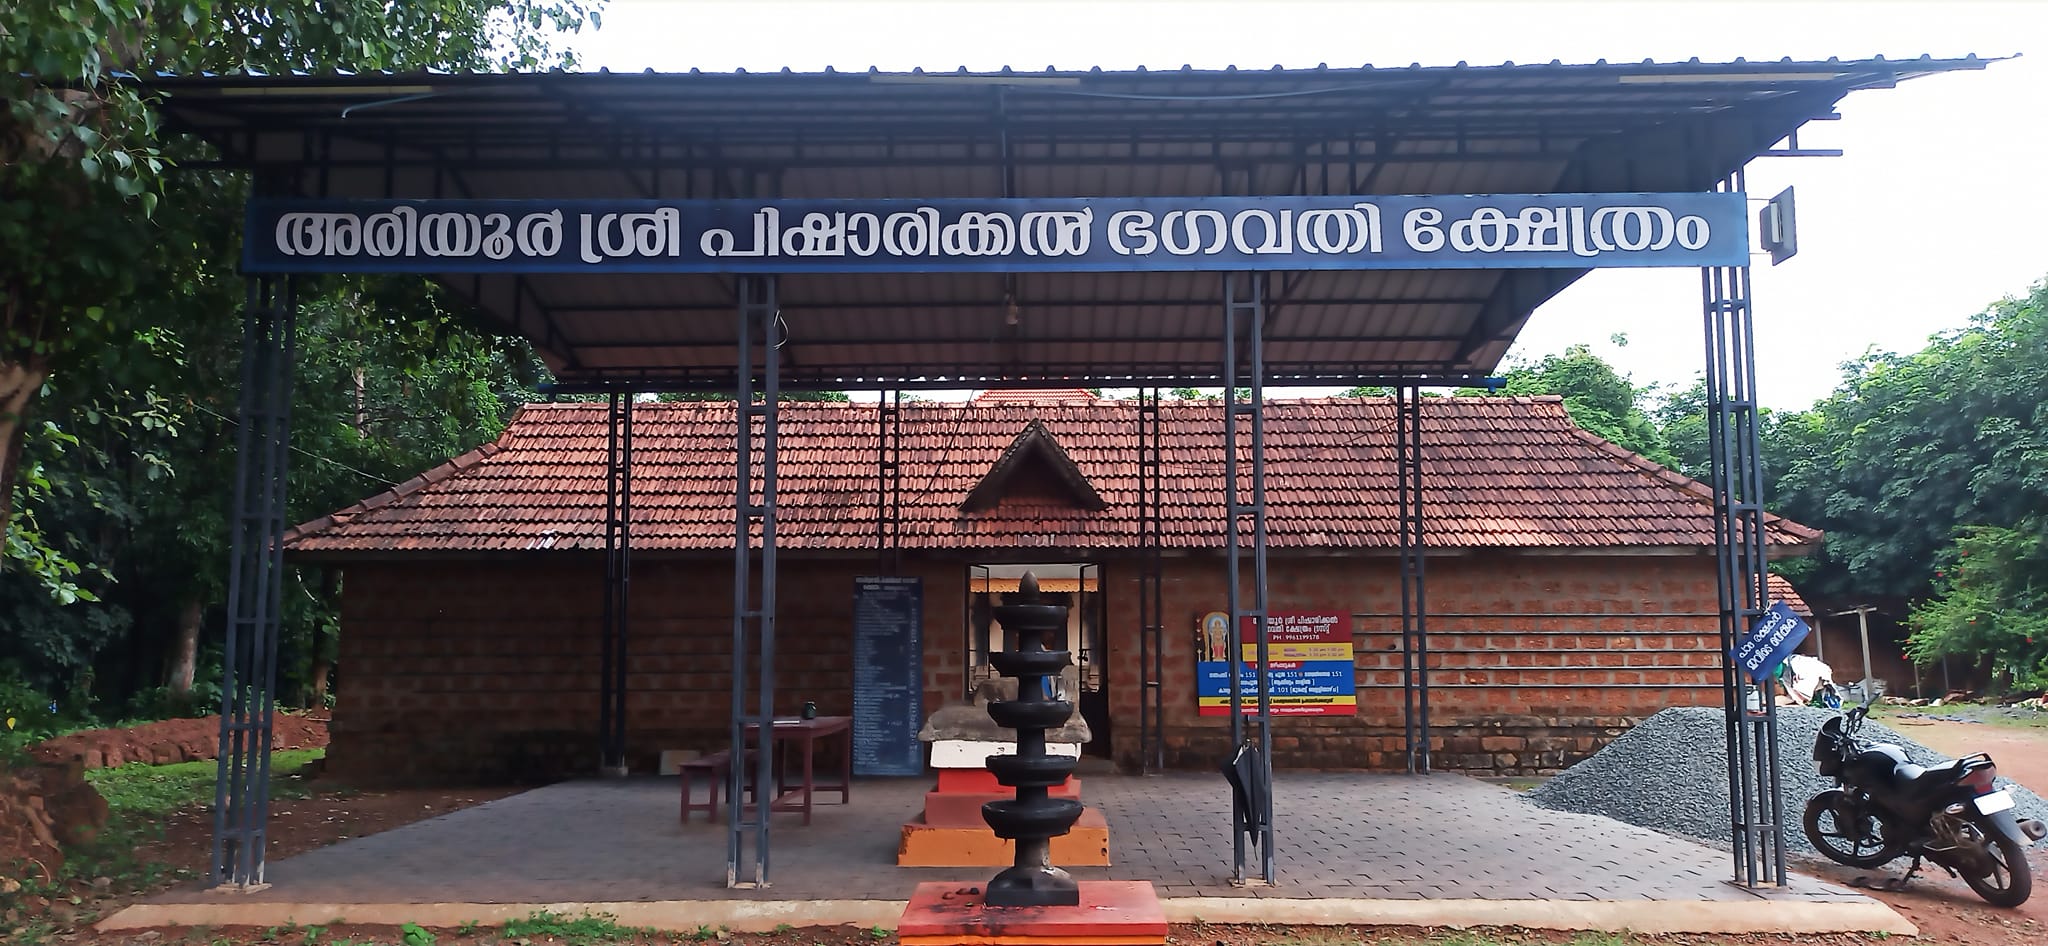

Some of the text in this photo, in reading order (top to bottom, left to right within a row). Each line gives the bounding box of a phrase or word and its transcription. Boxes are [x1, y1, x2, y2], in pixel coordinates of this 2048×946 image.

[275, 202, 1711, 263] അരിയൂർ ശ്രീ പിഷാരിക്കൽ ഭഗവതി ക്ഷേത്രം
